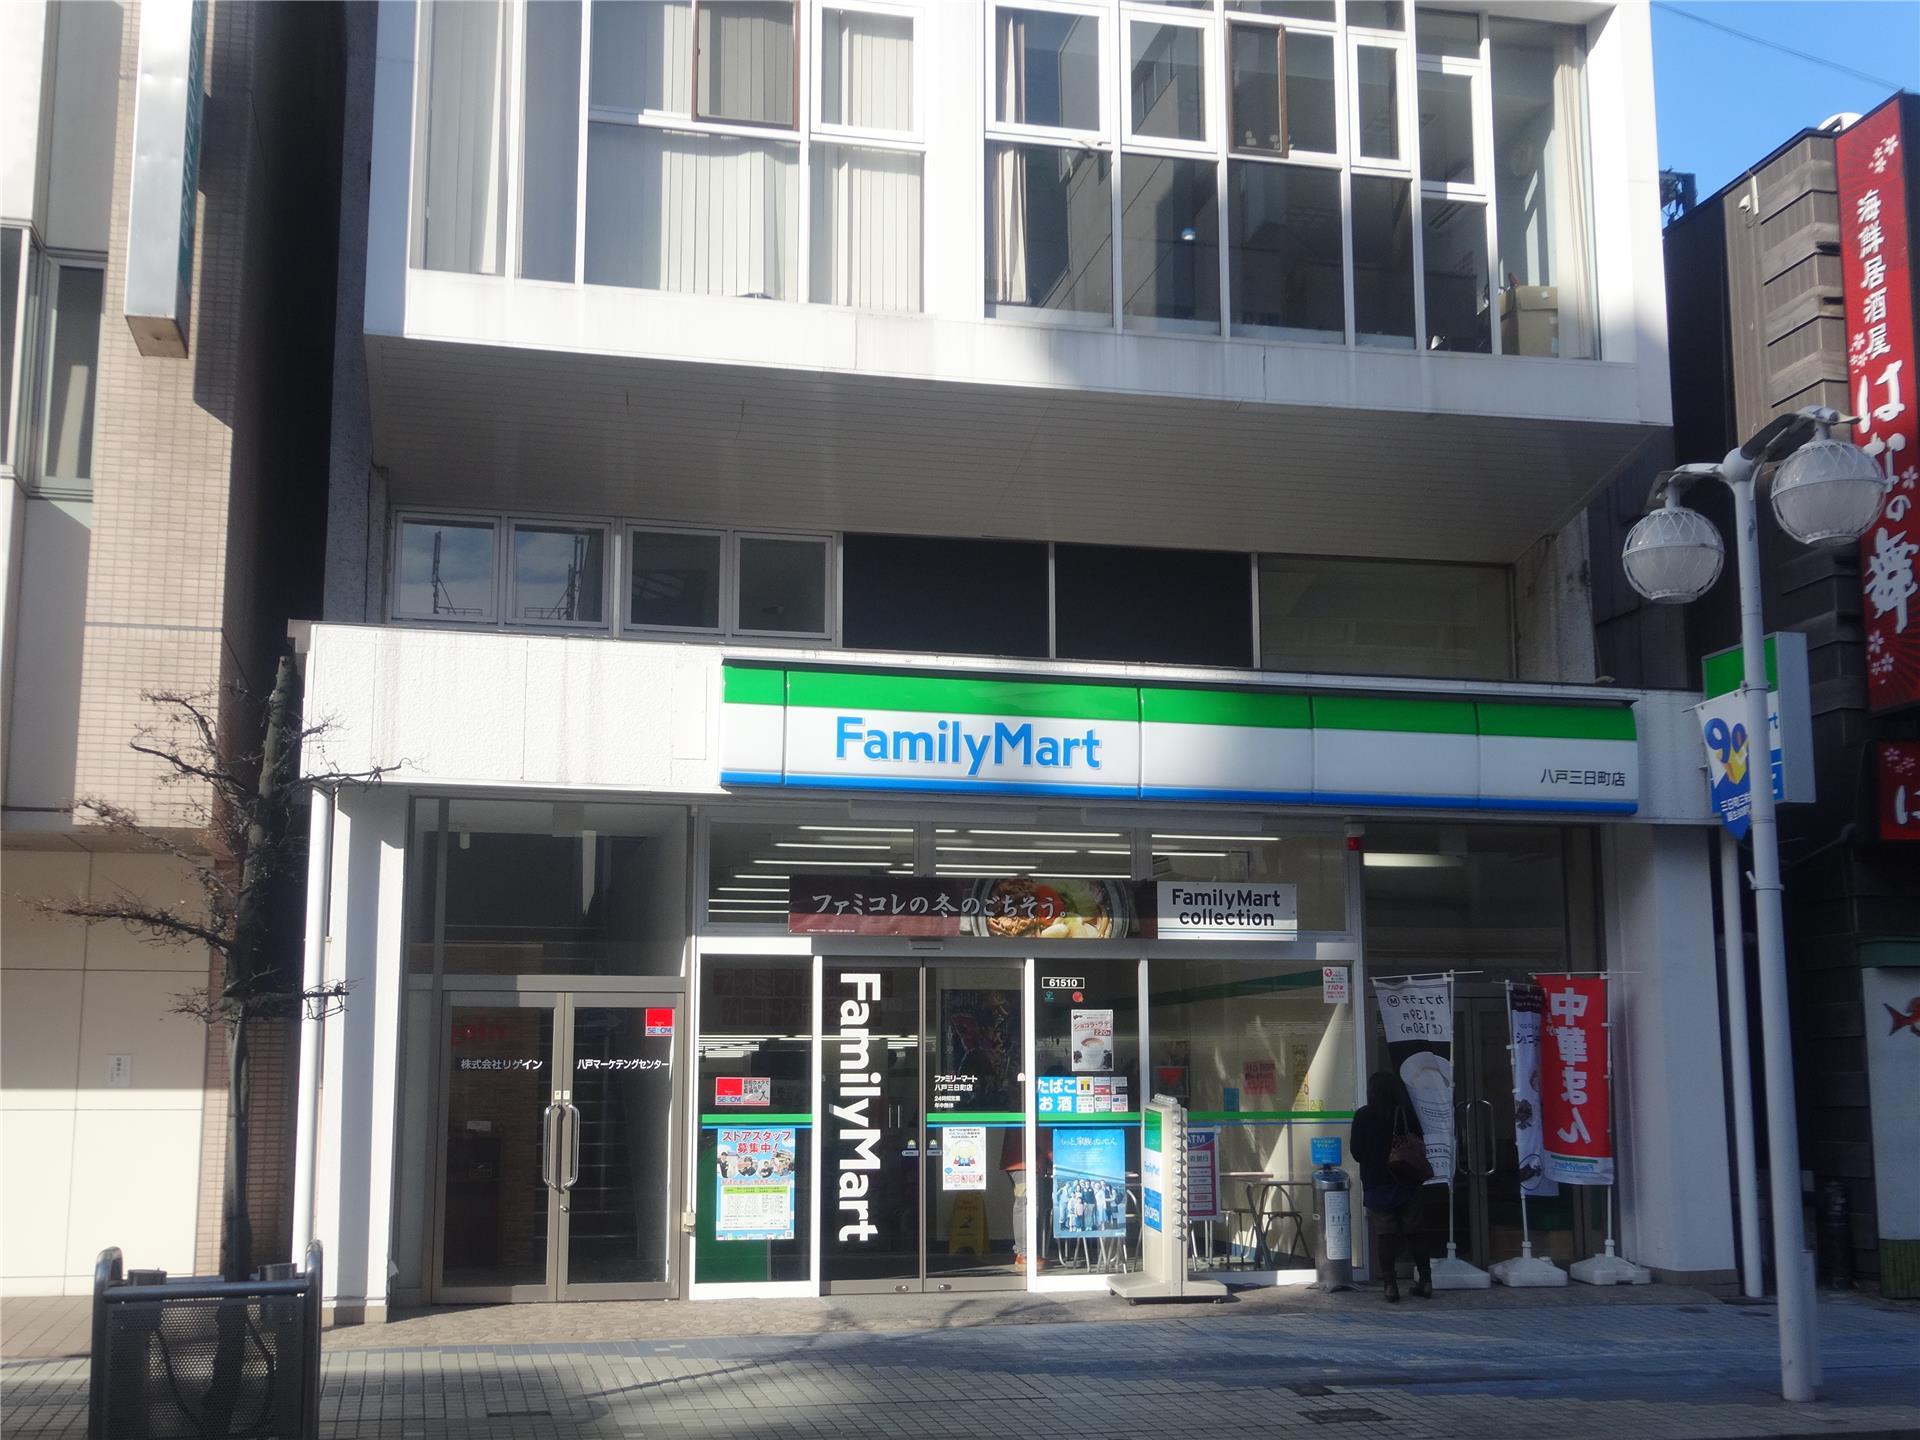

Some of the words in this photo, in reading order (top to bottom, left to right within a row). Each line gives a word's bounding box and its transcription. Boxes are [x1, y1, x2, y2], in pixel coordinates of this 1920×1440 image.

[1856, 188, 1892, 356] 海鮮居酒屋
[836, 715, 1102, 776] FamilyMart
[1540, 767, 1626, 787] 八戸三日町店
[811, 891, 1068, 919] ファミコレの冬のごちそう。
[1171, 888, 1281, 909] FamilyMart
[1179, 908, 1275, 929] collection
[1049, 979, 1078, 987] 61510
[460, 1058, 543, 1070] 株式会社リゲイン
[934, 1074, 978, 1083] ファミリーマート
[934, 1083, 974, 1092] 八戸三日町店
[1038, 1078, 1077, 1094] たばこ
[829, 972, 881, 1242] FamilyMart
[1039, 1096, 1073, 1112] お酒
[722, 1131, 792, 1141] ストアスタッフ
